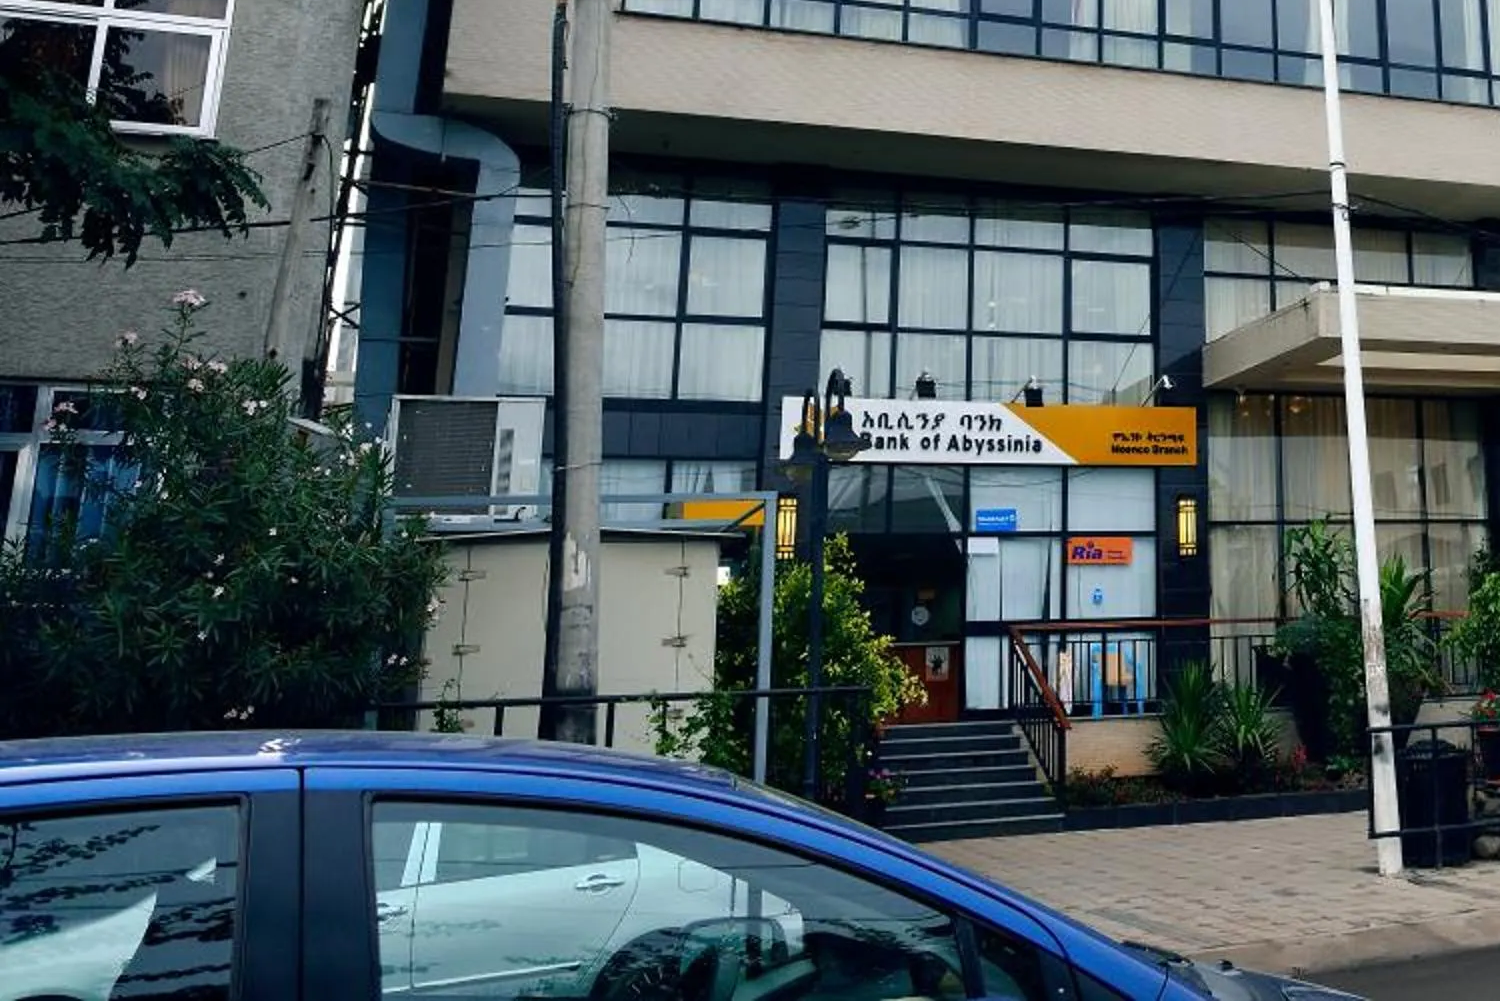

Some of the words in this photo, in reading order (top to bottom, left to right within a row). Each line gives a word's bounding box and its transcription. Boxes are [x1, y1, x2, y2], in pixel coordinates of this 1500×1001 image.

[959, 412, 1003, 432] ባንክ
[860, 431, 911, 451] Bank
[919, 433, 941, 451] of
[946, 433, 1043, 456] Abyssinia
[1071, 540, 1104, 560] Ria
